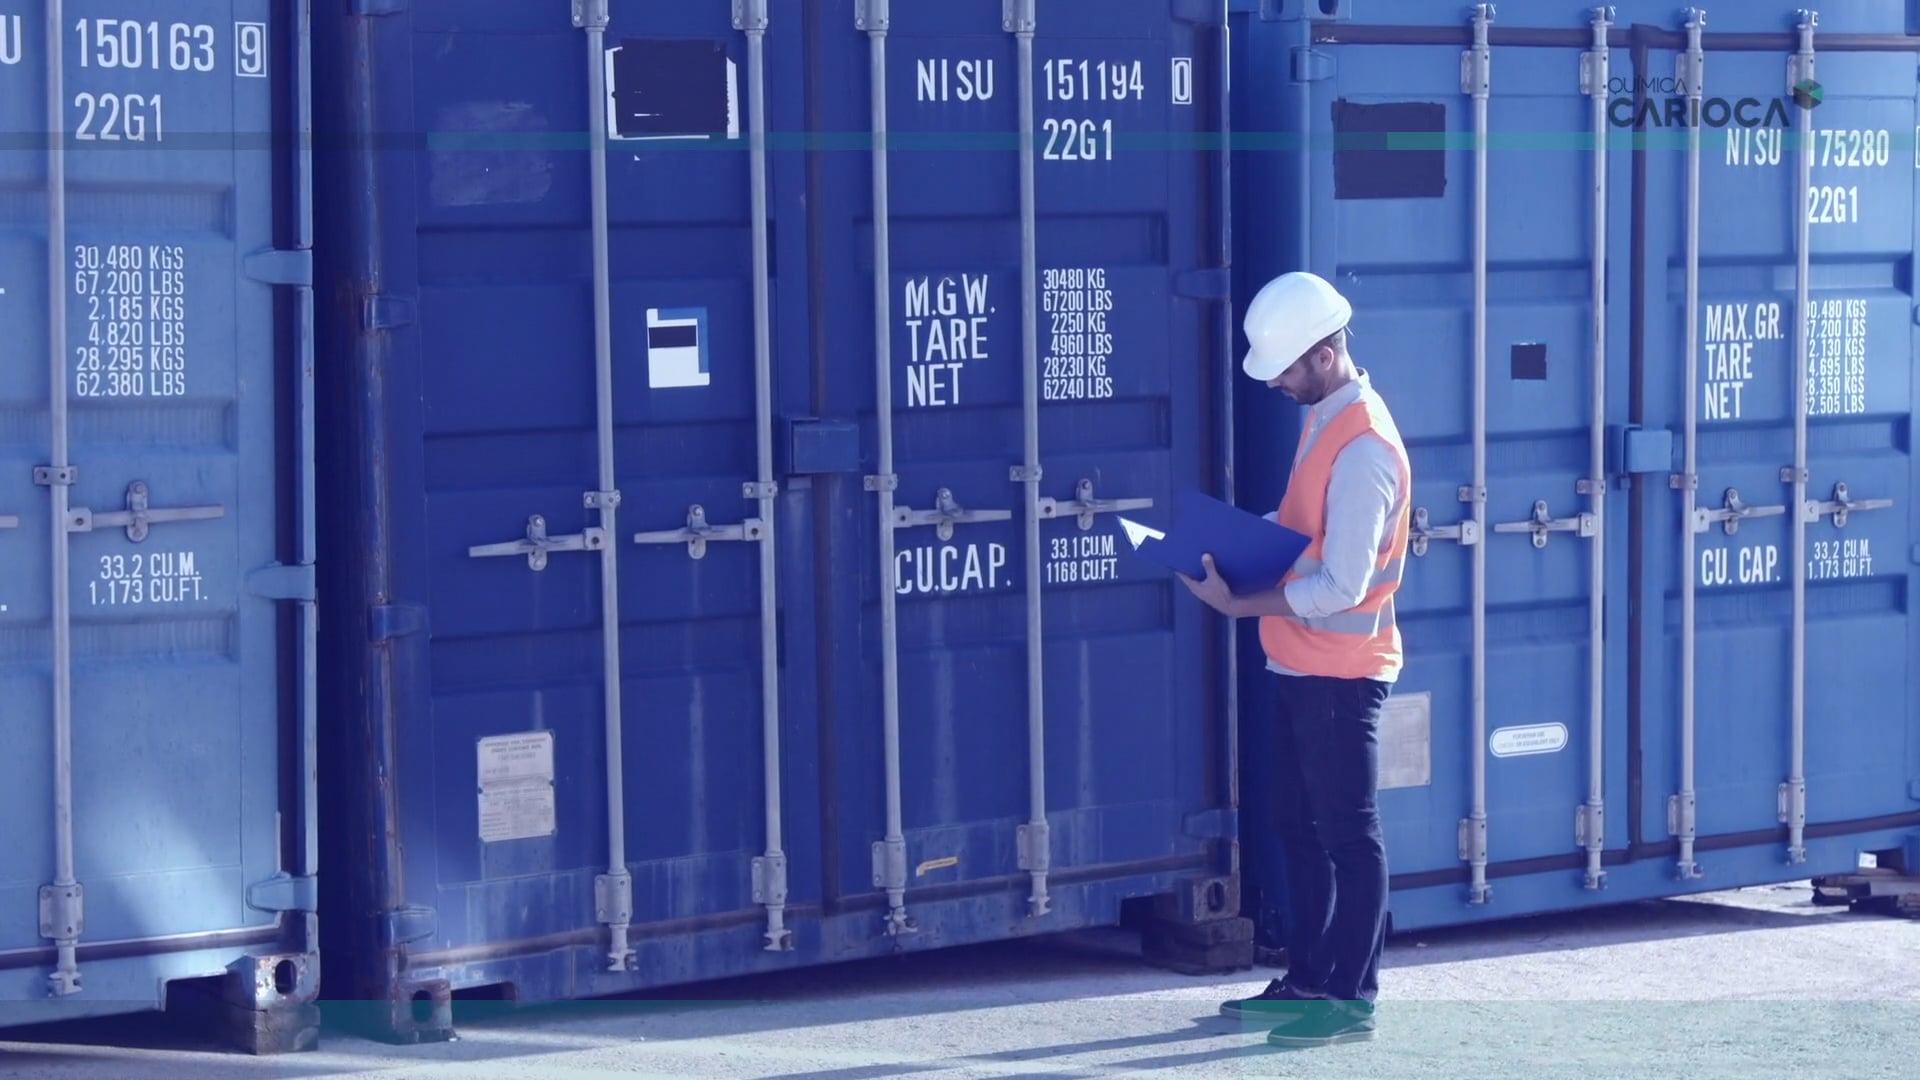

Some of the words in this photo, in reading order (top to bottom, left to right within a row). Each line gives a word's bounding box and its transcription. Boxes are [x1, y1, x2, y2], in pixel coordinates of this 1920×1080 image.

[0, 14, 21, 65] U
[75, 18, 215, 72] 150163
[238, 23, 264, 75] 9
[917, 58, 994, 102] NISU
[1043, 58, 1145, 101] 151194
[74, 92, 162, 142] 22G1
[1042, 118, 1112, 161] 22G1
[1725, 127, 1782, 166] NISU
[1807, 183, 1858, 224] 22G1
[74, 245, 143, 270] 30,480
[149, 245, 184, 270] KGS
[75, 270, 143, 295] 67,200
[149, 270, 184, 295] LBS
[1043, 268, 1084, 290] 30480
[1087, 268, 1106, 289] KG
[88, 295, 143, 321] 2,185
[150, 295, 184, 321] KGS
[1043, 290, 1084, 312] 67200
[1087, 289, 1113, 311] LBS
[1845, 299, 1867, 318] KGS
[88, 321, 143, 346] 4,820
[150, 321, 185, 346] LBS
[1051, 312, 1084, 334] 2250
[1087, 311, 1106, 333] KG
[1845, 318, 1866, 337] LBS
[905, 316, 988, 362] TARE
[1051, 334, 1084, 356] 4960
[1087, 333, 1113, 355] LBS
[1808, 338, 1841, 358] 2,130
[1844, 337, 1865, 357] KGS
[76, 346, 143, 371] 28,295
[150, 346, 185, 371] KGS
[1043, 356, 1084, 378] 28230
[1087, 355, 1106, 377] KG
[1705, 342, 1753, 381] TARE
[1808, 357, 1841, 377] 4,695
[1844, 356, 1865, 376] LBS
[76, 371, 144, 397] 62,380
[150, 371, 185, 396] LBS
[906, 362, 964, 407] NET
[1043, 378, 1084, 400] 62240
[1087, 377, 1113, 399] LBS
[1805, 376, 1841, 396] 8,350
[1844, 375, 1865, 395] KGS
[1704, 381, 1744, 420] NET
[1805, 395, 1841, 415] 2,505
[1844, 394, 1865, 414] LBS
[1051, 537, 1078, 560] 33.1
[1081, 535, 1117, 558] CU.M.
[1813, 540, 1840, 561] 33.2
[100, 554, 143, 580] 33.2
[150, 551, 200, 577] CU.M.
[1046, 560, 1078, 583] 1168
[1081, 558, 1118, 581] CU.FT.
[1701, 547, 1733, 586] CU.
[1739, 545, 1780, 584] CAP.
[1808, 559, 1839, 579] 1,173
[1842, 557, 1873, 578] CU.FT.
[89, 579, 143, 605] 1,173
[150, 576, 208, 602] CU.FT.
